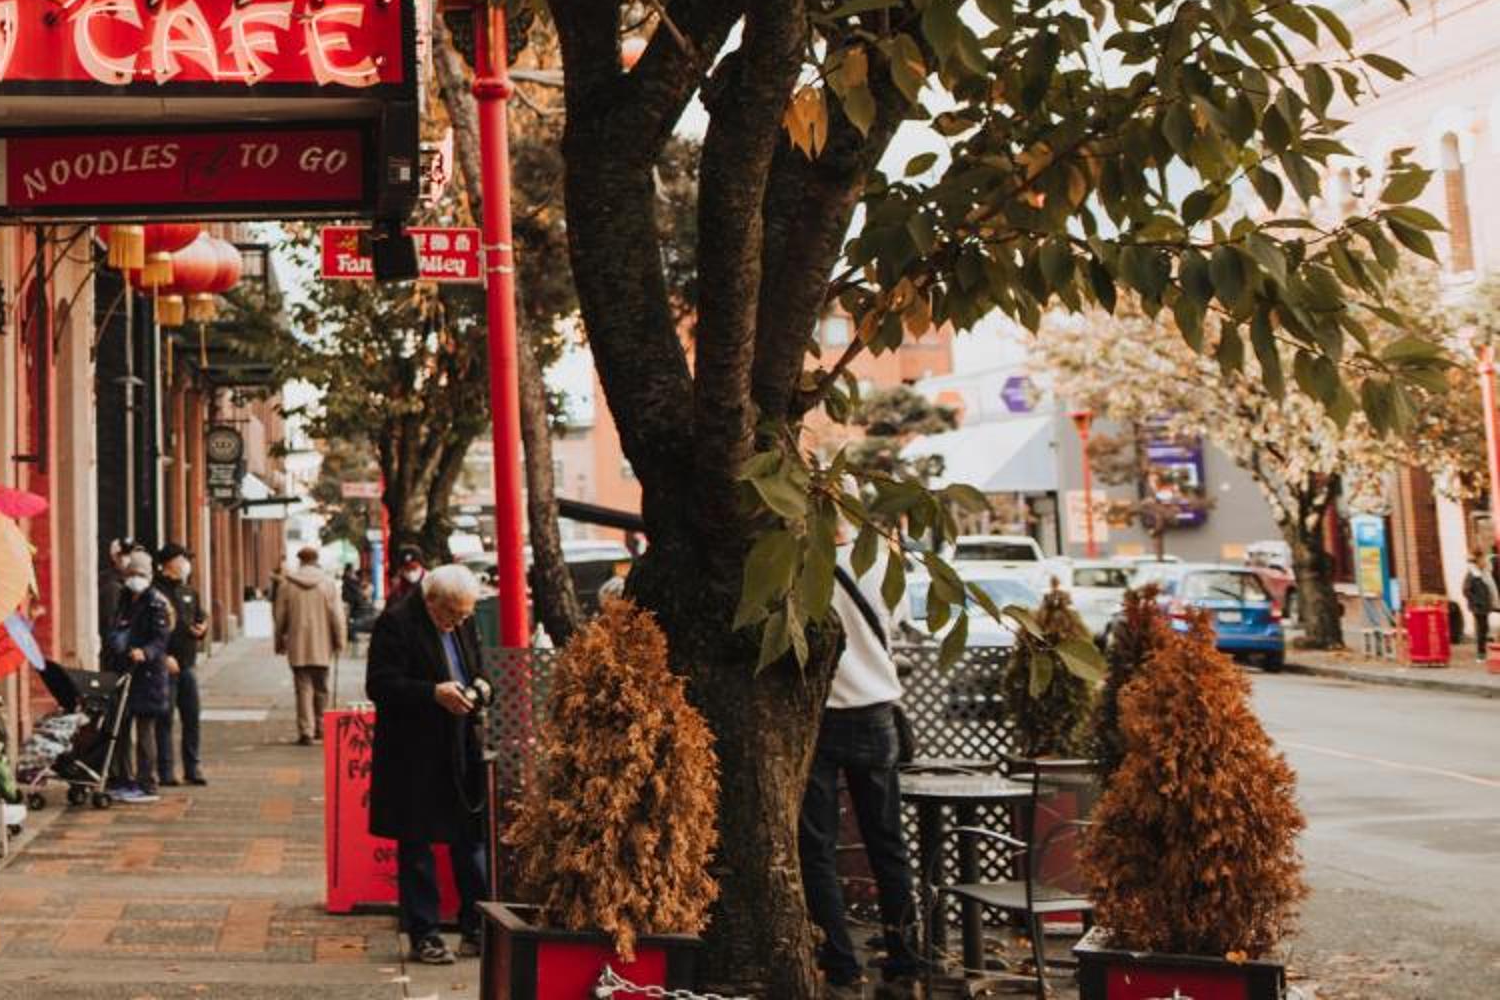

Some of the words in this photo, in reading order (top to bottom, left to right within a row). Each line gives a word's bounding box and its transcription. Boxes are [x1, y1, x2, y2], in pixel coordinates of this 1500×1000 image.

[22, 143, 180, 199] NOODLES
[239, 143, 279, 169] TO
[299, 146, 348, 175] GO
